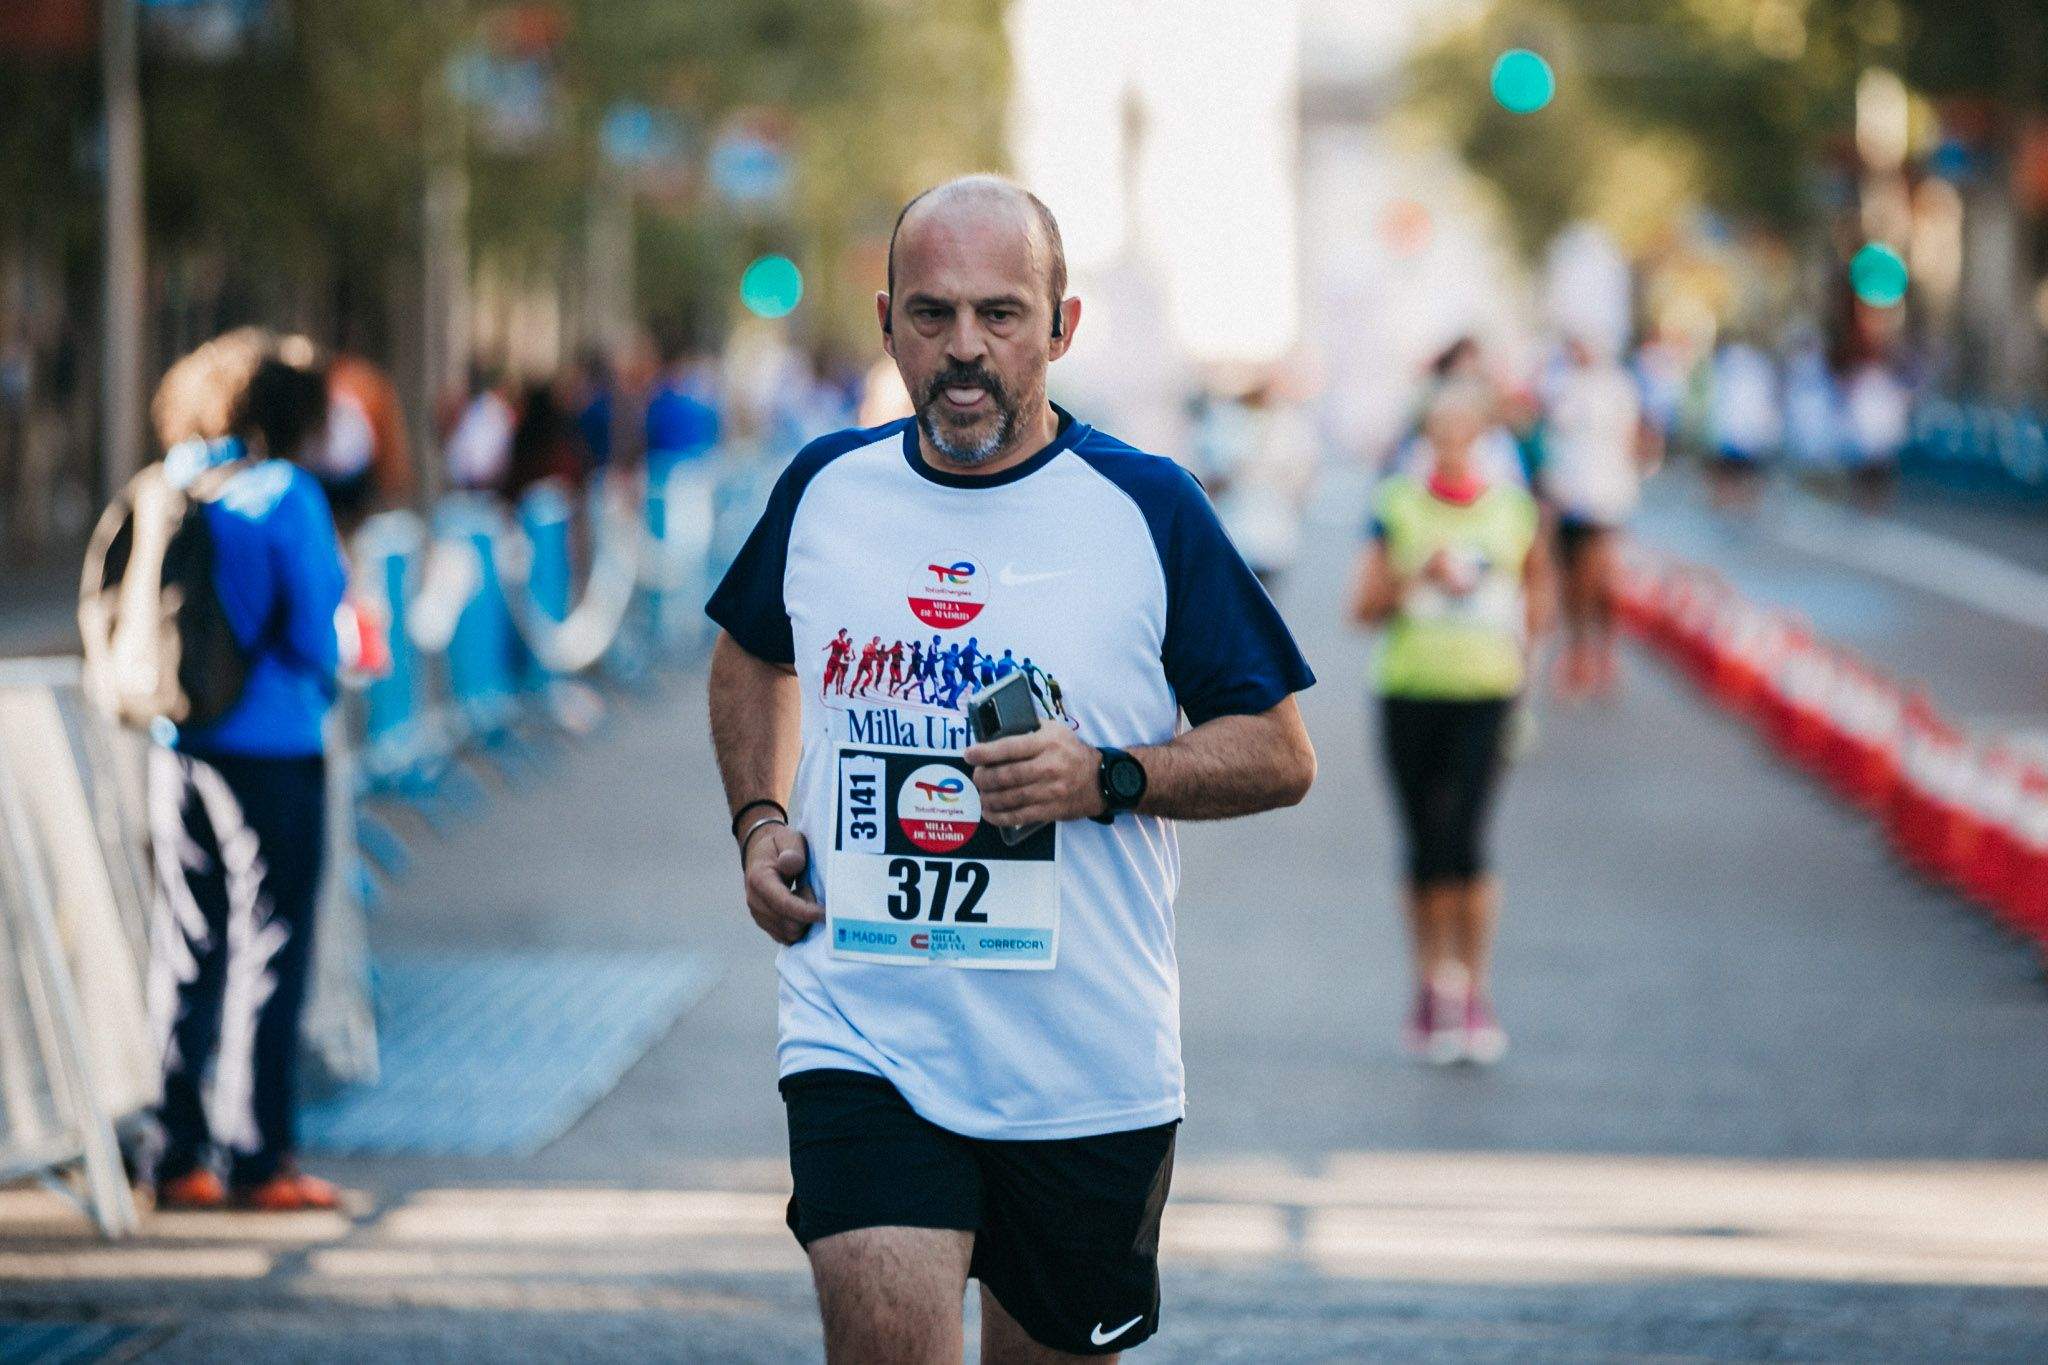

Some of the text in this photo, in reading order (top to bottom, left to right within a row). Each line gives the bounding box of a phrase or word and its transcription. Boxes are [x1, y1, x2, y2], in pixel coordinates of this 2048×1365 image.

[847, 708, 919, 748] Milla
[850, 774, 877, 840] 3141
[913, 831, 965, 842] DE MADRID
[924, 822, 953, 832] MILLA
[887, 858, 990, 923] 372
[852, 931, 898, 946] MADRID
